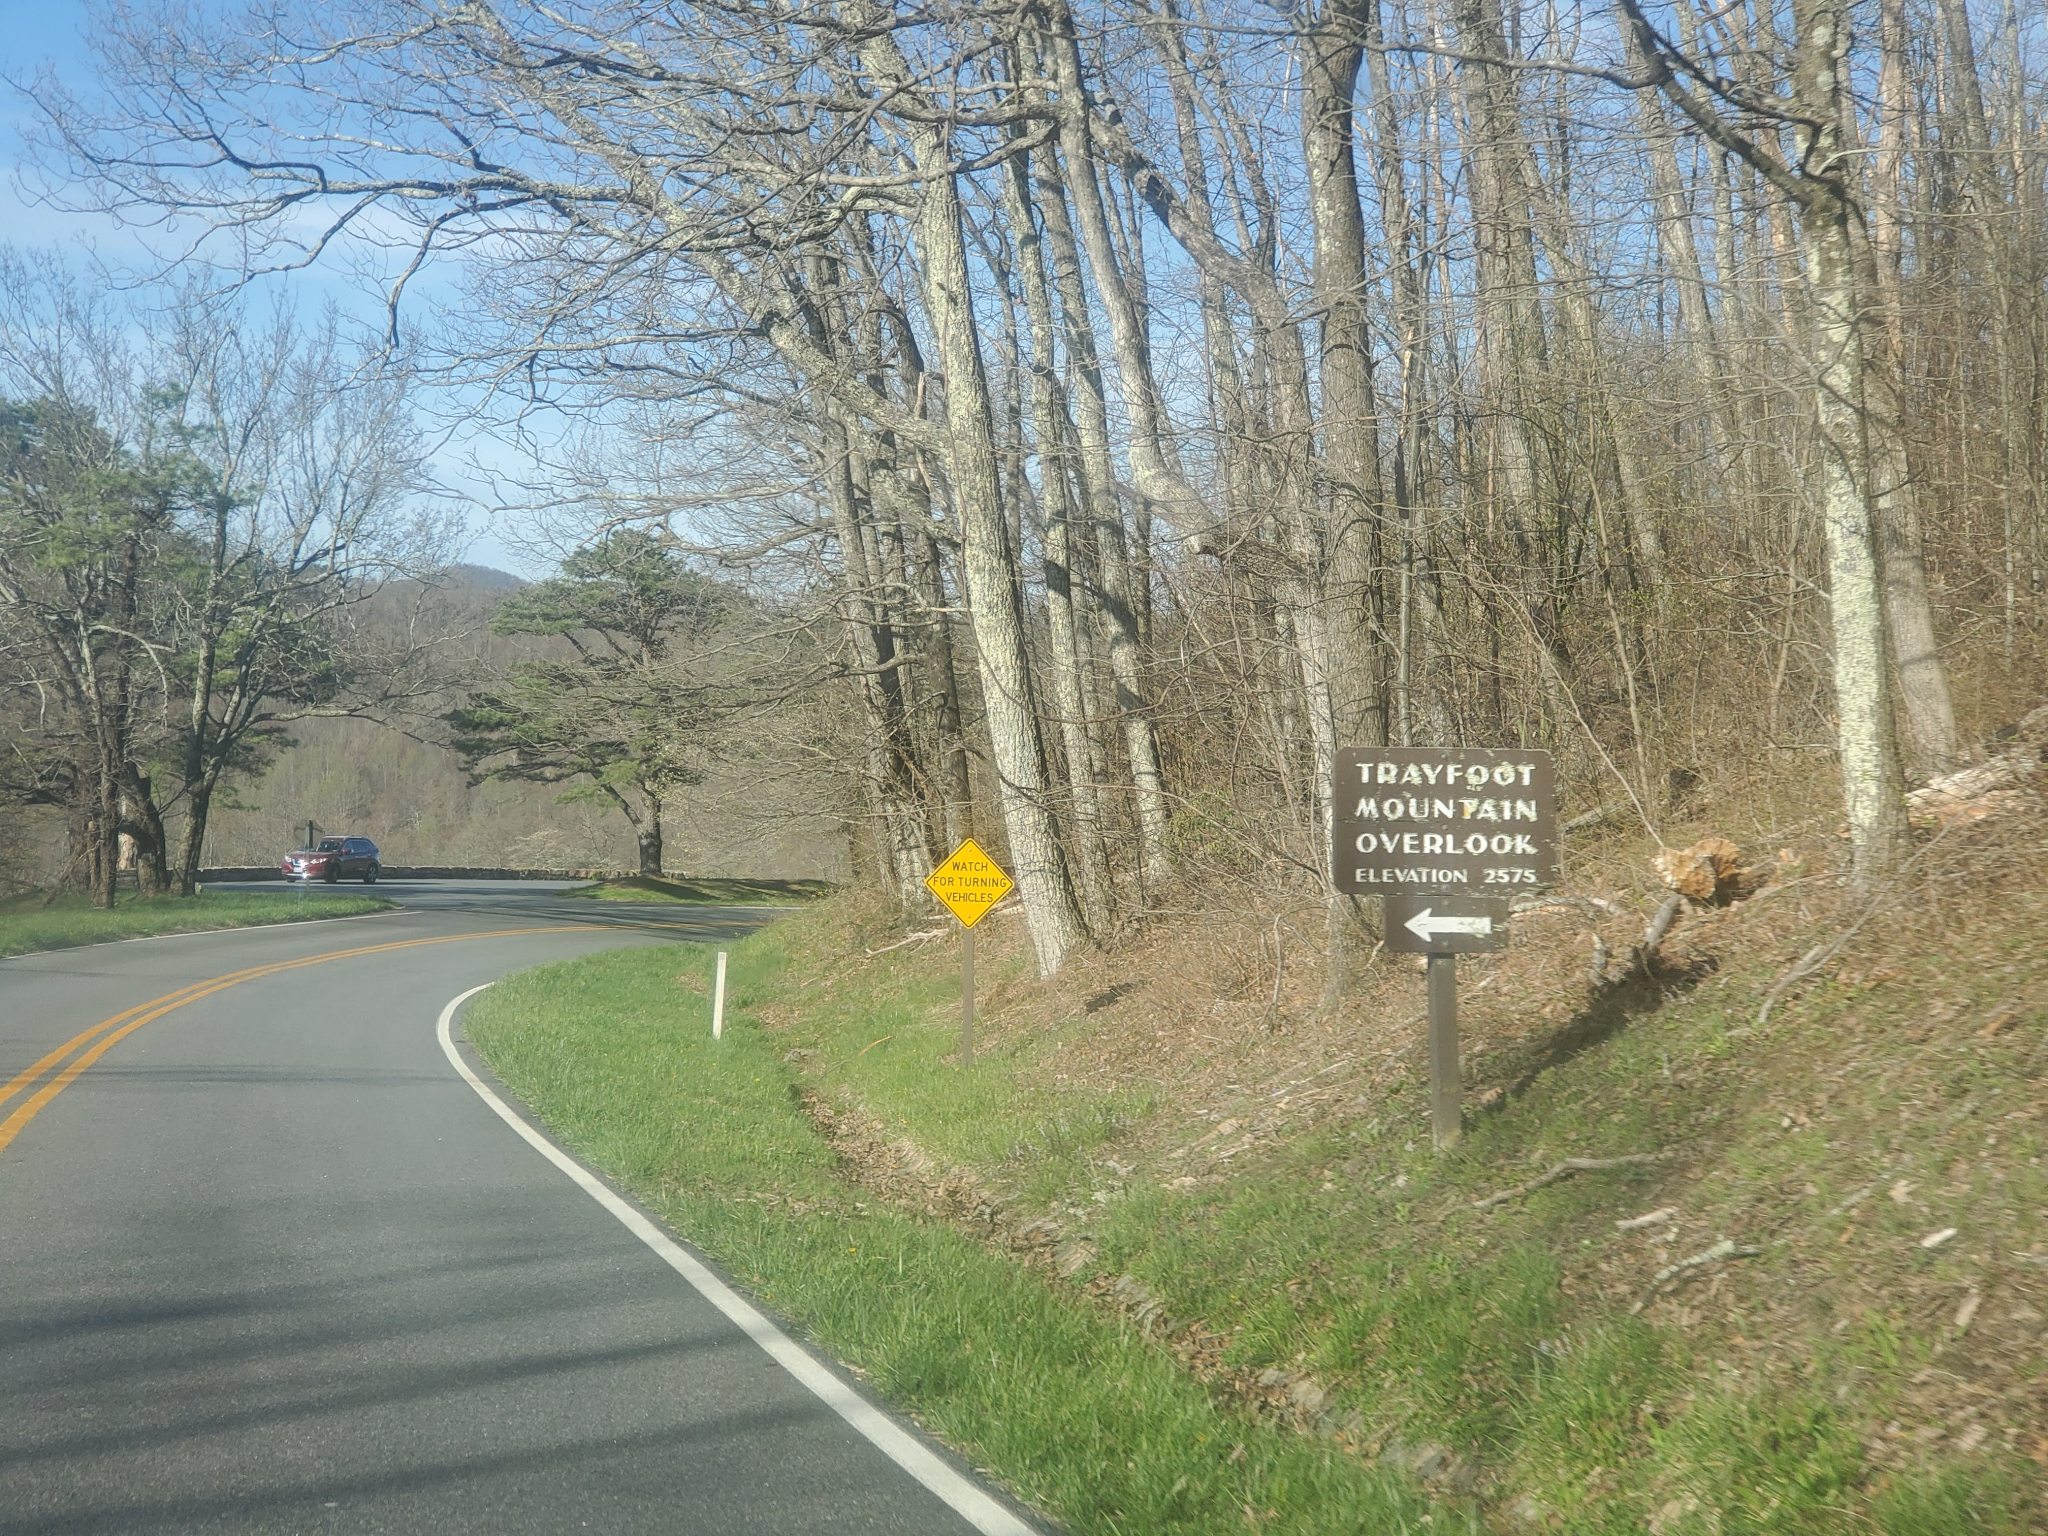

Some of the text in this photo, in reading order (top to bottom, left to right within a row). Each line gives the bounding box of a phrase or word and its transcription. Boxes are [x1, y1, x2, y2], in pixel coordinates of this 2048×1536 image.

[1355, 762, 1536, 786] TRAYFOOT
[1354, 797, 1538, 821] MOUNTAIN
[1355, 833, 1538, 854] OVERLOOK
[952, 861, 988, 872] WATCH
[933, 876, 1007, 888] FOR TURNING
[1355, 868, 1537, 883] ELEVATION 2575
[945, 892, 993, 903] VEHICLES
